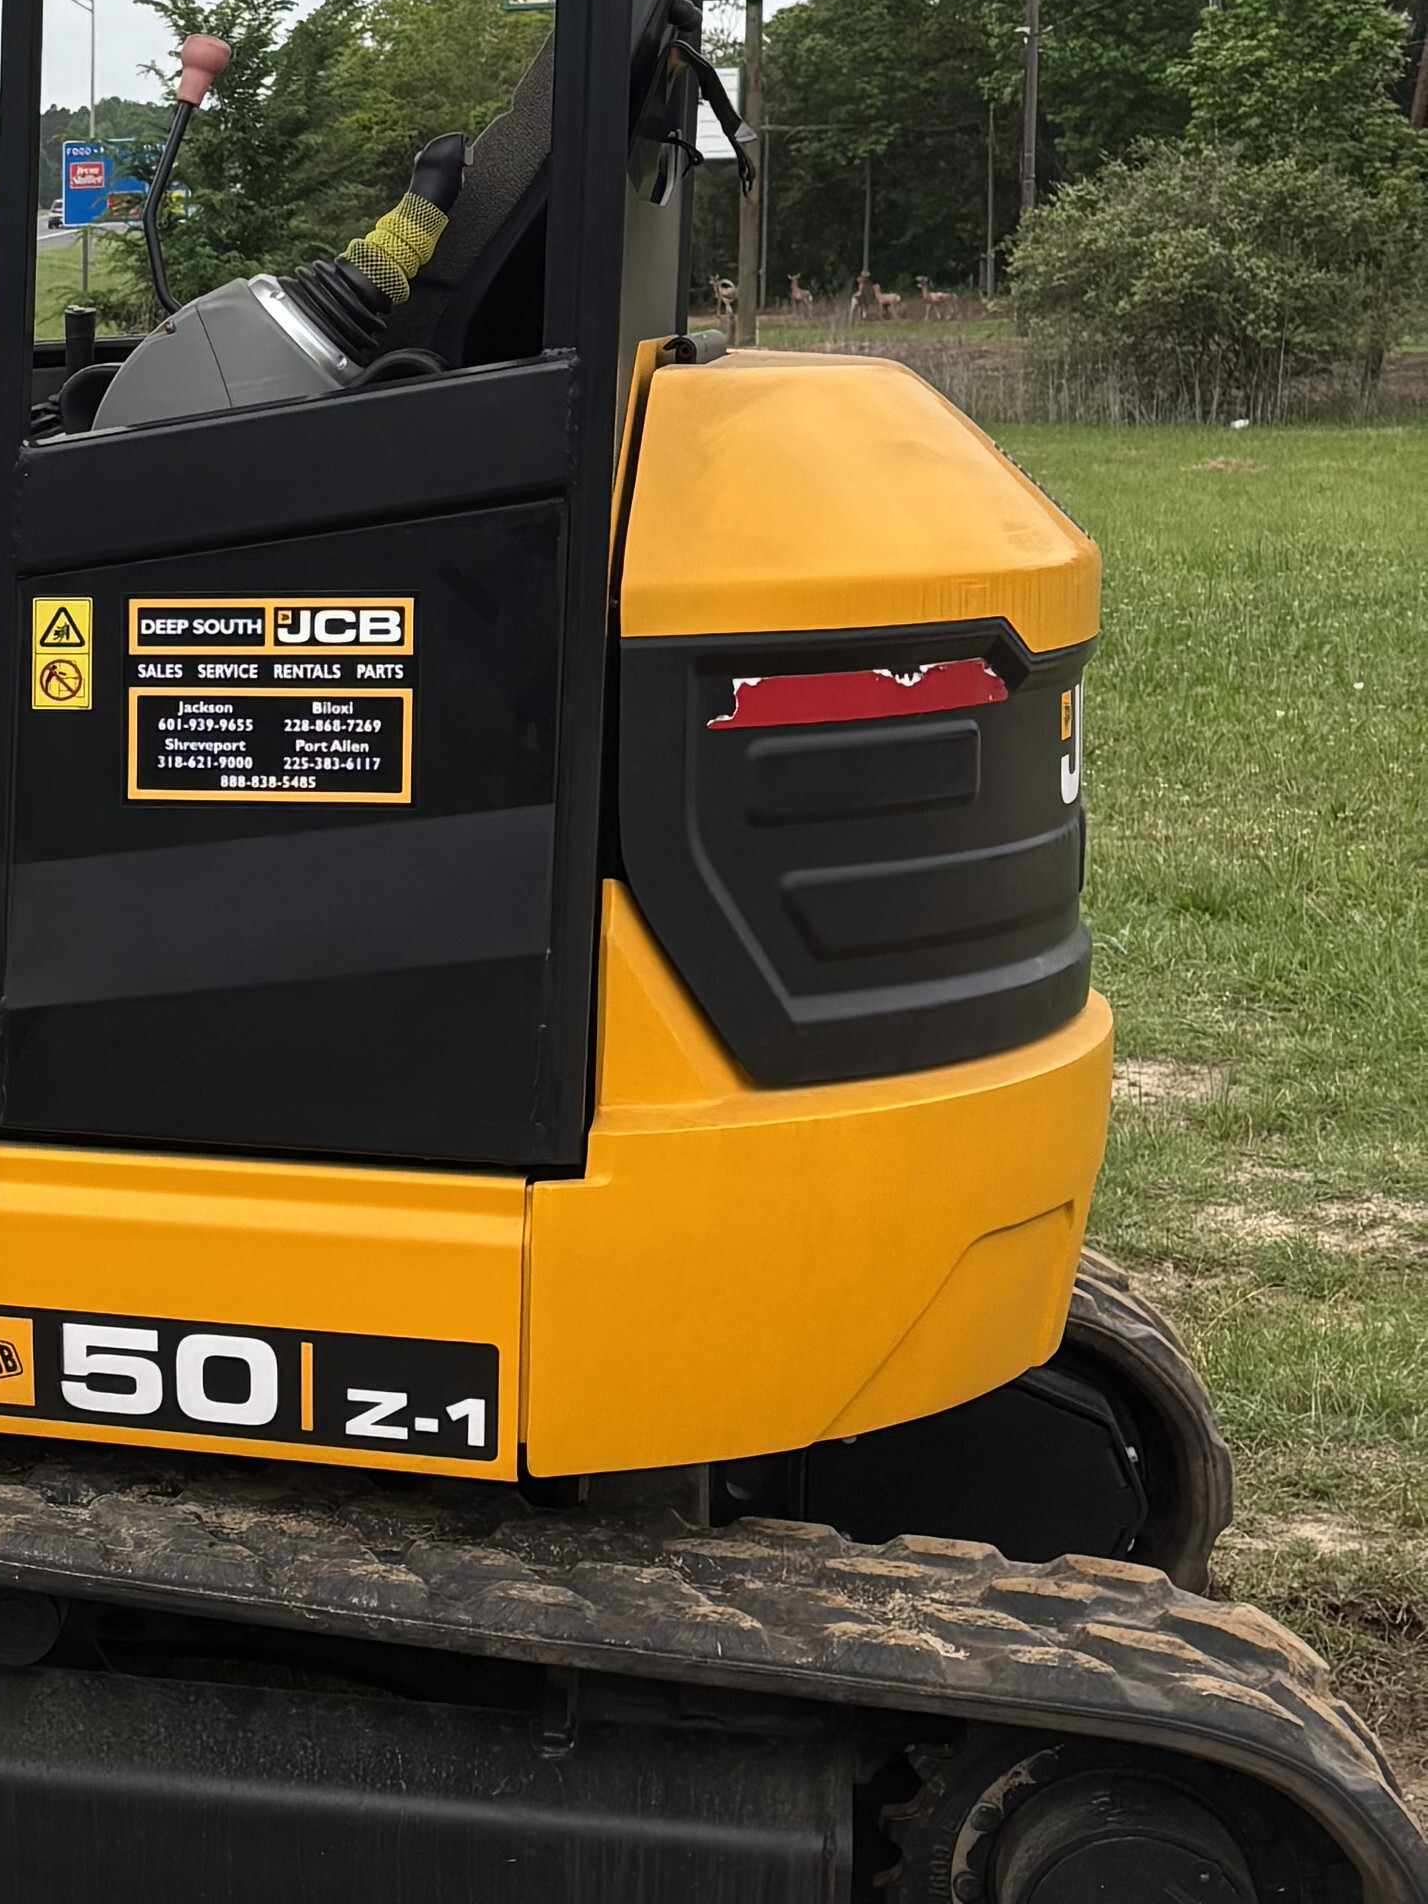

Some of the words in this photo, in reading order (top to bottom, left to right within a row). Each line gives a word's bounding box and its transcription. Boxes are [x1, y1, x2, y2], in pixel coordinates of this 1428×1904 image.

[140, 619, 189, 635] DEEP
[192, 619, 262, 635] SOUTH
[277, 610, 402, 643] JCB
[137, 663, 183, 678] SALES
[197, 663, 259, 678] SERVICE
[274, 664, 341, 679] RENTALS
[357, 664, 404, 679] PARTS
[178, 701, 233, 716] Jackson
[312, 701, 354, 715] Biloxi
[158, 718, 254, 732] 601-939-9655
[284, 719, 382, 733] 228-868-7269
[164, 738, 246, 753] Shreveport
[295, 739, 328, 753] Port
[330, 739, 370, 753] Allen
[157, 756, 253, 769] 318-621-9000
[283, 757, 381, 770] 225-383-6117
[61, 1323, 279, 1426] 50
[345, 1388, 487, 1447] Z-1
